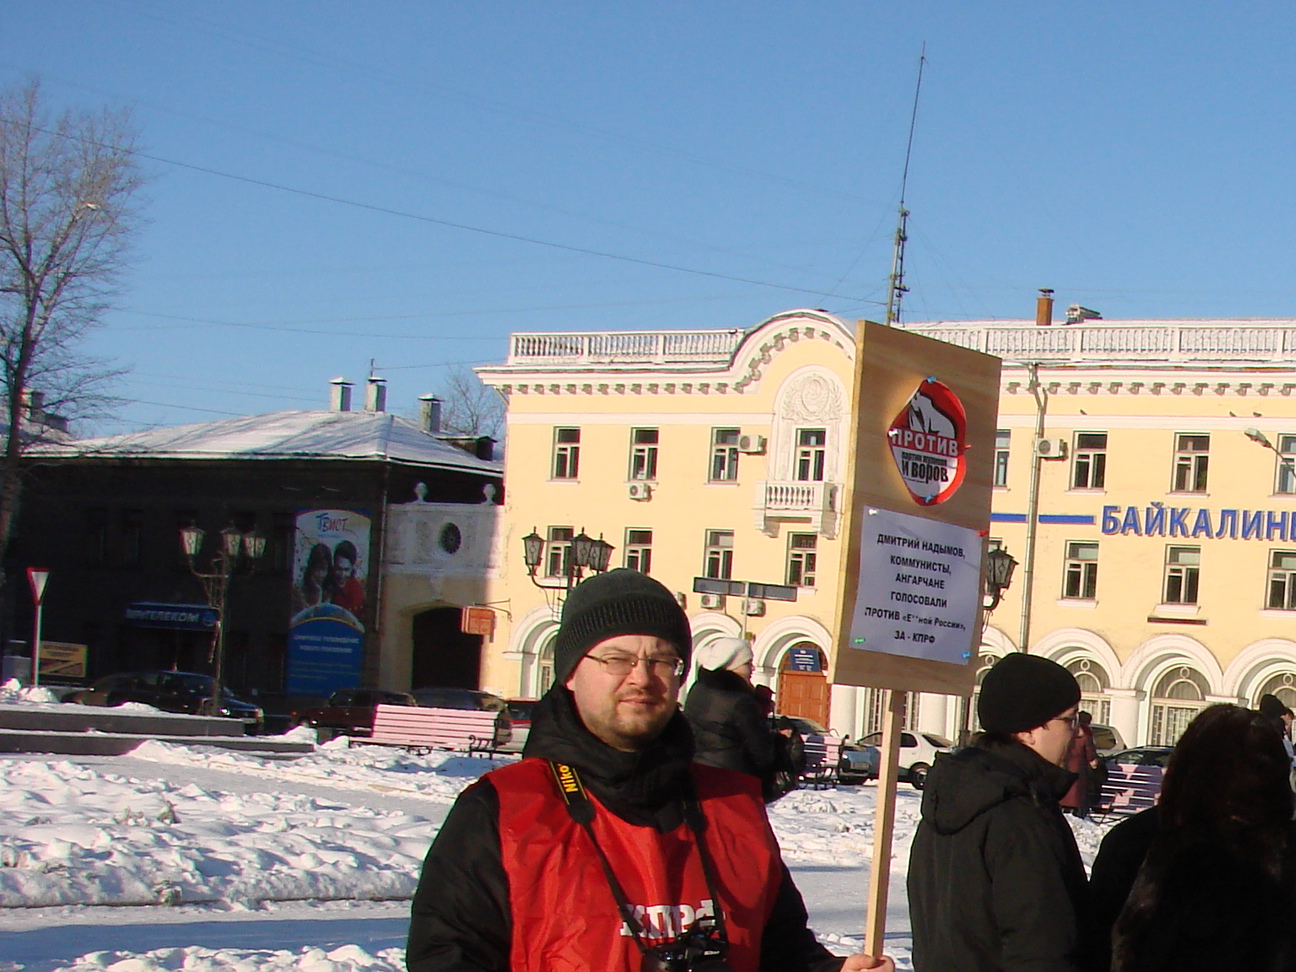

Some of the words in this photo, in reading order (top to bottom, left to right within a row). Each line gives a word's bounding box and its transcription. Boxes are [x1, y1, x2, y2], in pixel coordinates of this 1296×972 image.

[892, 429, 958, 456] ПРОТИВ
[877, 533, 919, 549] ДМИТРИЙ
[922, 541, 966, 558] НАДЫМОВ,
[890, 555, 952, 575] КОММУНИСТЫ,
[895, 573, 945, 589] АНГАРЧАНЕ
[891, 591, 947, 608] ГОЛОСОВАЛИ
[864, 606, 900, 621] ПРОТИВ
[894, 630, 906, 641] ЗА
[912, 632, 936, 643] КПРФ
[557, 763, 579, 793] Niko
